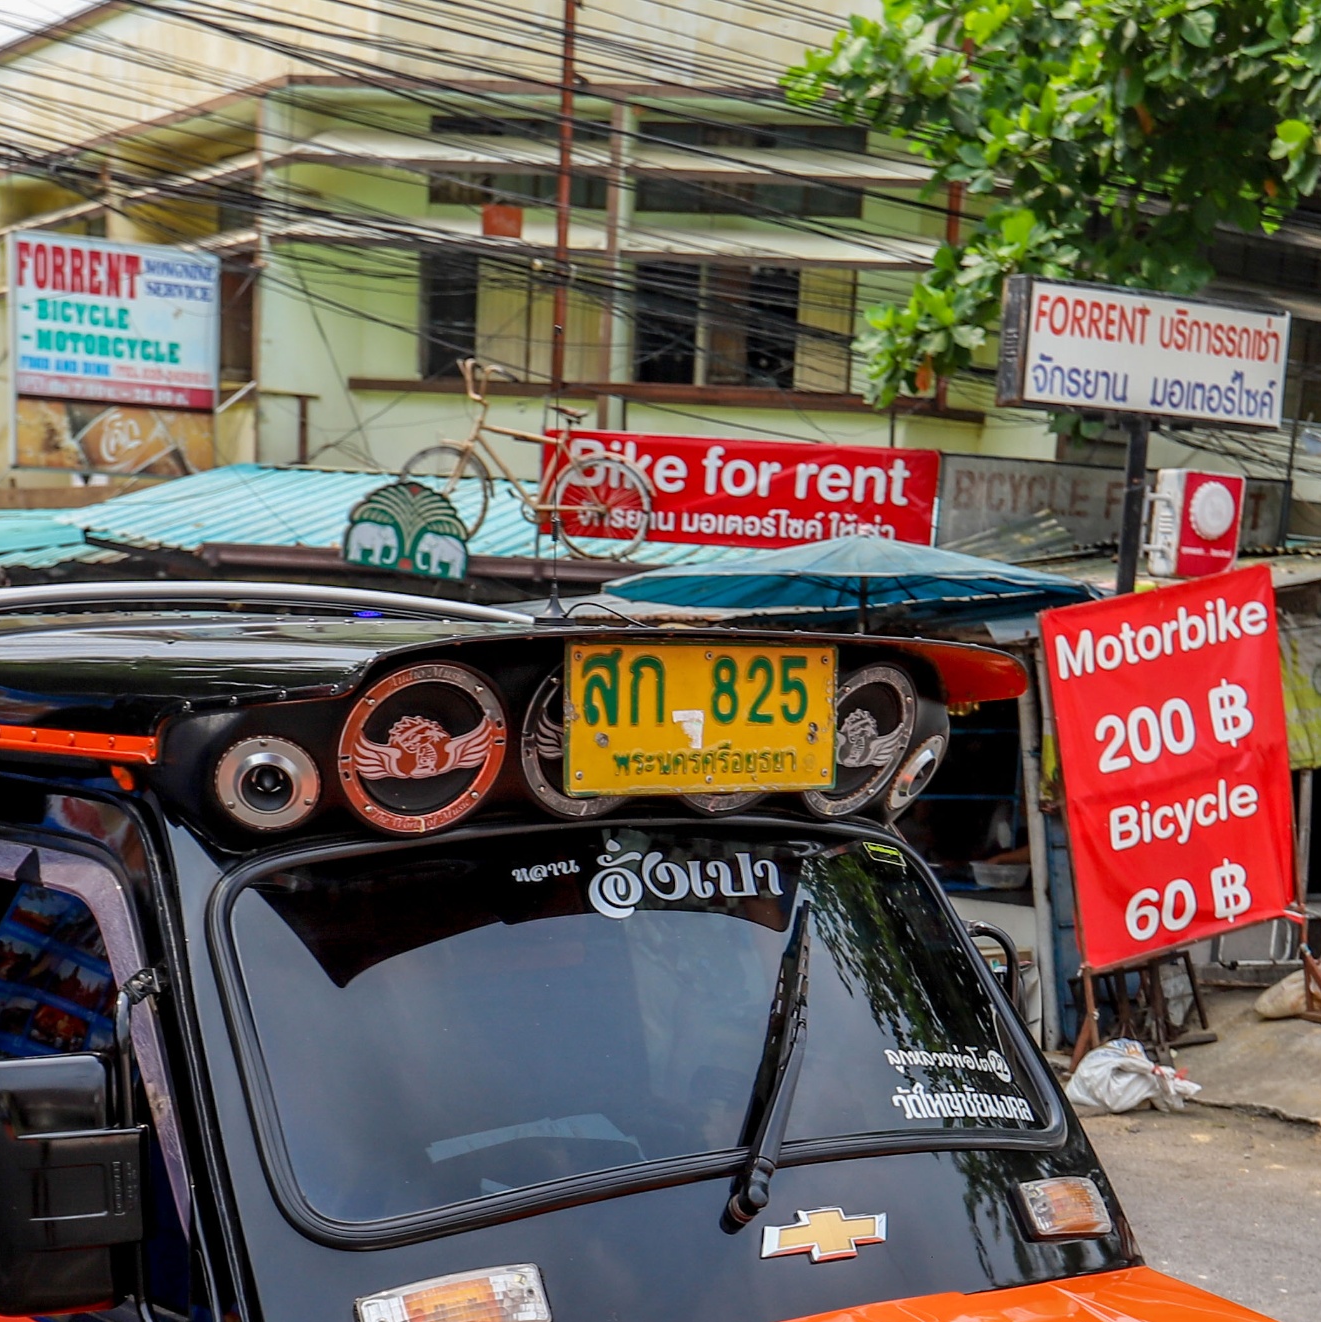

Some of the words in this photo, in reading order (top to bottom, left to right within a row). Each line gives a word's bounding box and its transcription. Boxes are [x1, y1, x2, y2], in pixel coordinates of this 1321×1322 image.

[16, 241, 141, 299] FORRENT
[36, 298, 130, 329] BICYCLE
[1034, 294, 1152, 345] FORRENT
[1159, 307, 1281, 364] บริการรถเช่า
[36, 329, 181, 364] MOTORCYCLE
[1031, 353, 1129, 402] จักรยาน
[569, 439, 688, 493] Bike
[701, 446, 783, 498] for
[795, 458, 913, 506] rent
[954, 468, 1089, 519] BICYCLE
[1055, 597, 1268, 680] Motorbike
[582, 647, 665, 726] สก
[711, 655, 809, 725] 825
[613, 740, 798, 780] พระนครศรีอยุธยา
[1094, 697, 1196, 774] 200
[1109, 778, 1259, 851] Bicycle
[511, 858, 580, 884] หลาน
[1125, 878, 1197, 941] 60
[891, 1081, 1035, 1122] วัดใหญ่ชัยมงคล
